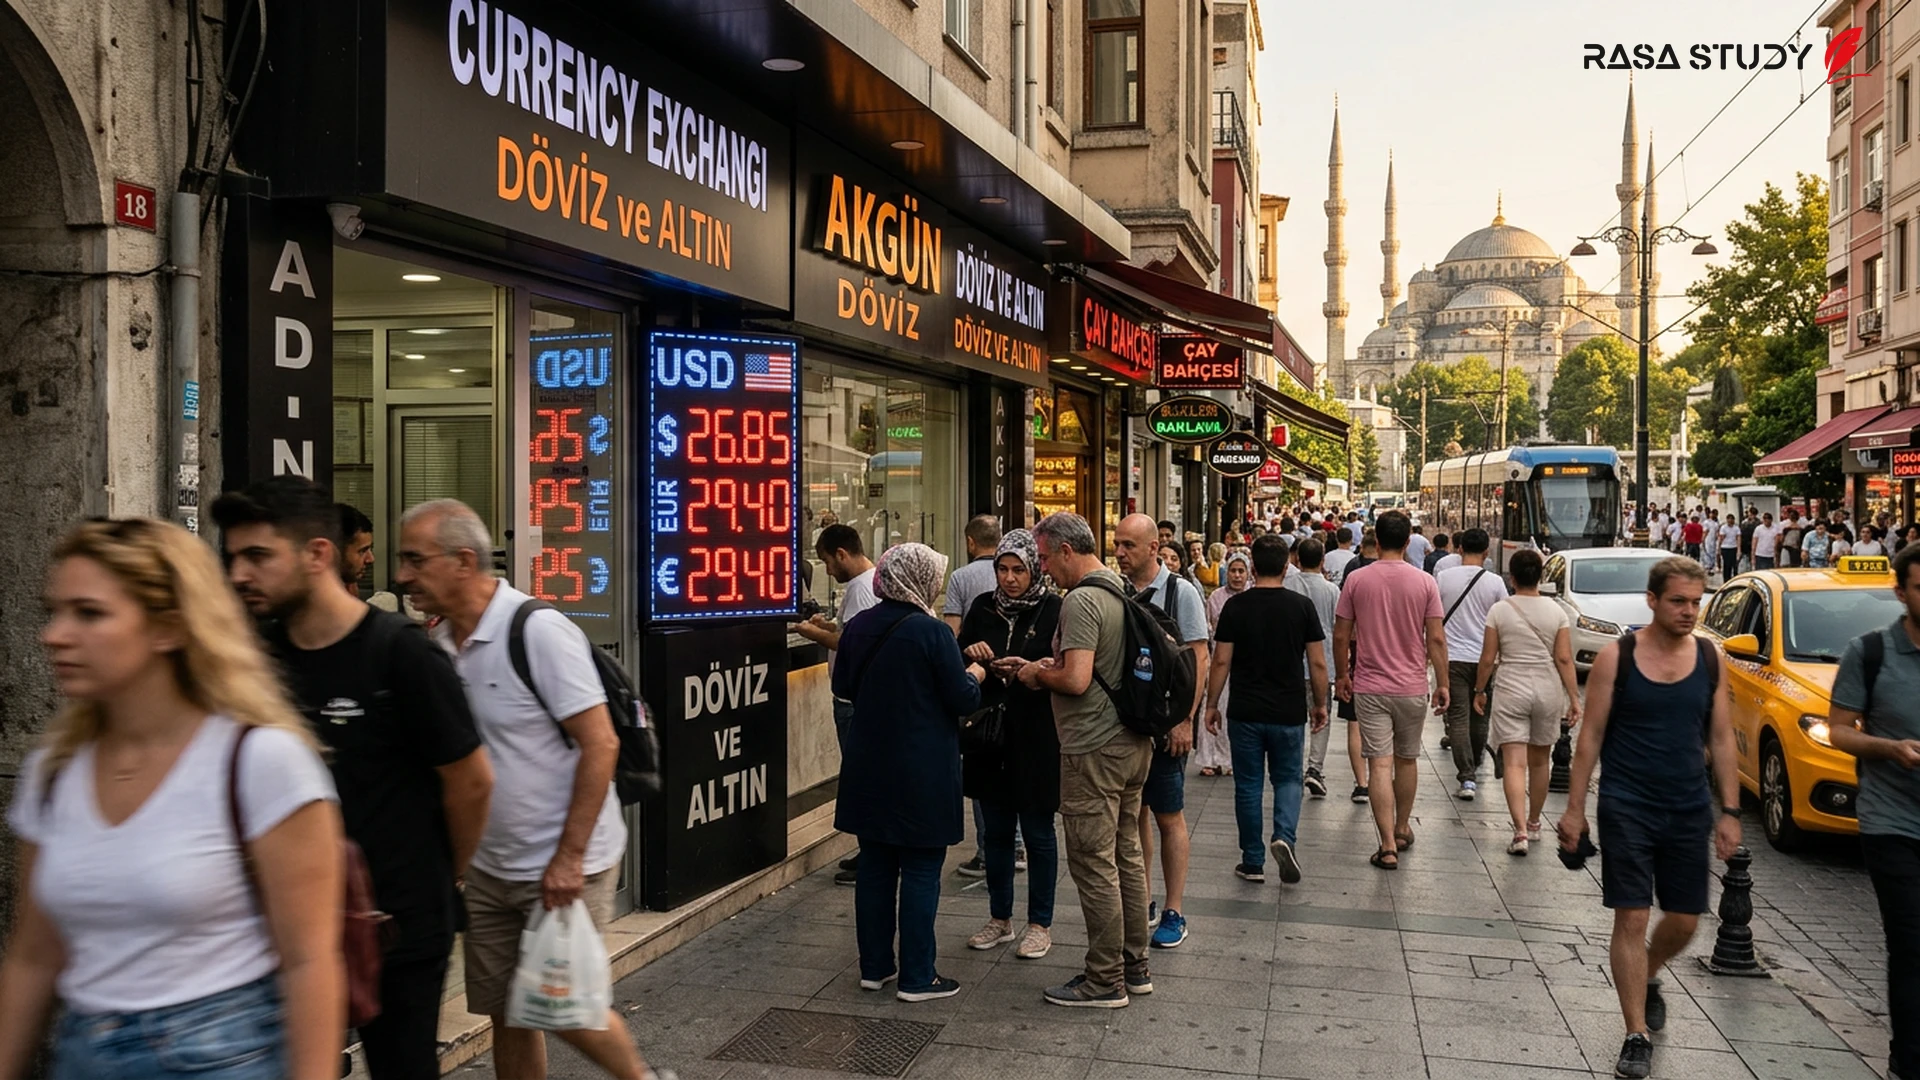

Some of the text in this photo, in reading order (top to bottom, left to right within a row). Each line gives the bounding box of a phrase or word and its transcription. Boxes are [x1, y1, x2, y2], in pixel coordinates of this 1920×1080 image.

[449, 0, 639, 154] CURRENCY
[124, 192, 147, 220] 18
[498, 133, 732, 271] DÖVİZ ve ALTIN
[824, 174, 941, 295] AKGÜN
[838, 277, 920, 341] DÖVİZ
[956, 243, 1044, 331] DÖVİZ VE ALTIN
[954, 314, 1041, 373] DÖVİZ VE ALTIN
[1084, 298, 1109, 350] ÇAY
[1184, 343, 1220, 362] ÇAY
[657, 347, 735, 389] USD
[1163, 357, 1239, 382] BAHÇESİ
[658, 408, 791, 465] $ 26.85
[657, 478, 791, 533] EUR 29.40
[656, 546, 791, 602] € 29.40
[684, 655, 769, 721] DÖVİZ
[714, 724, 742, 761] VE
[686, 763, 767, 830] ALTIN
